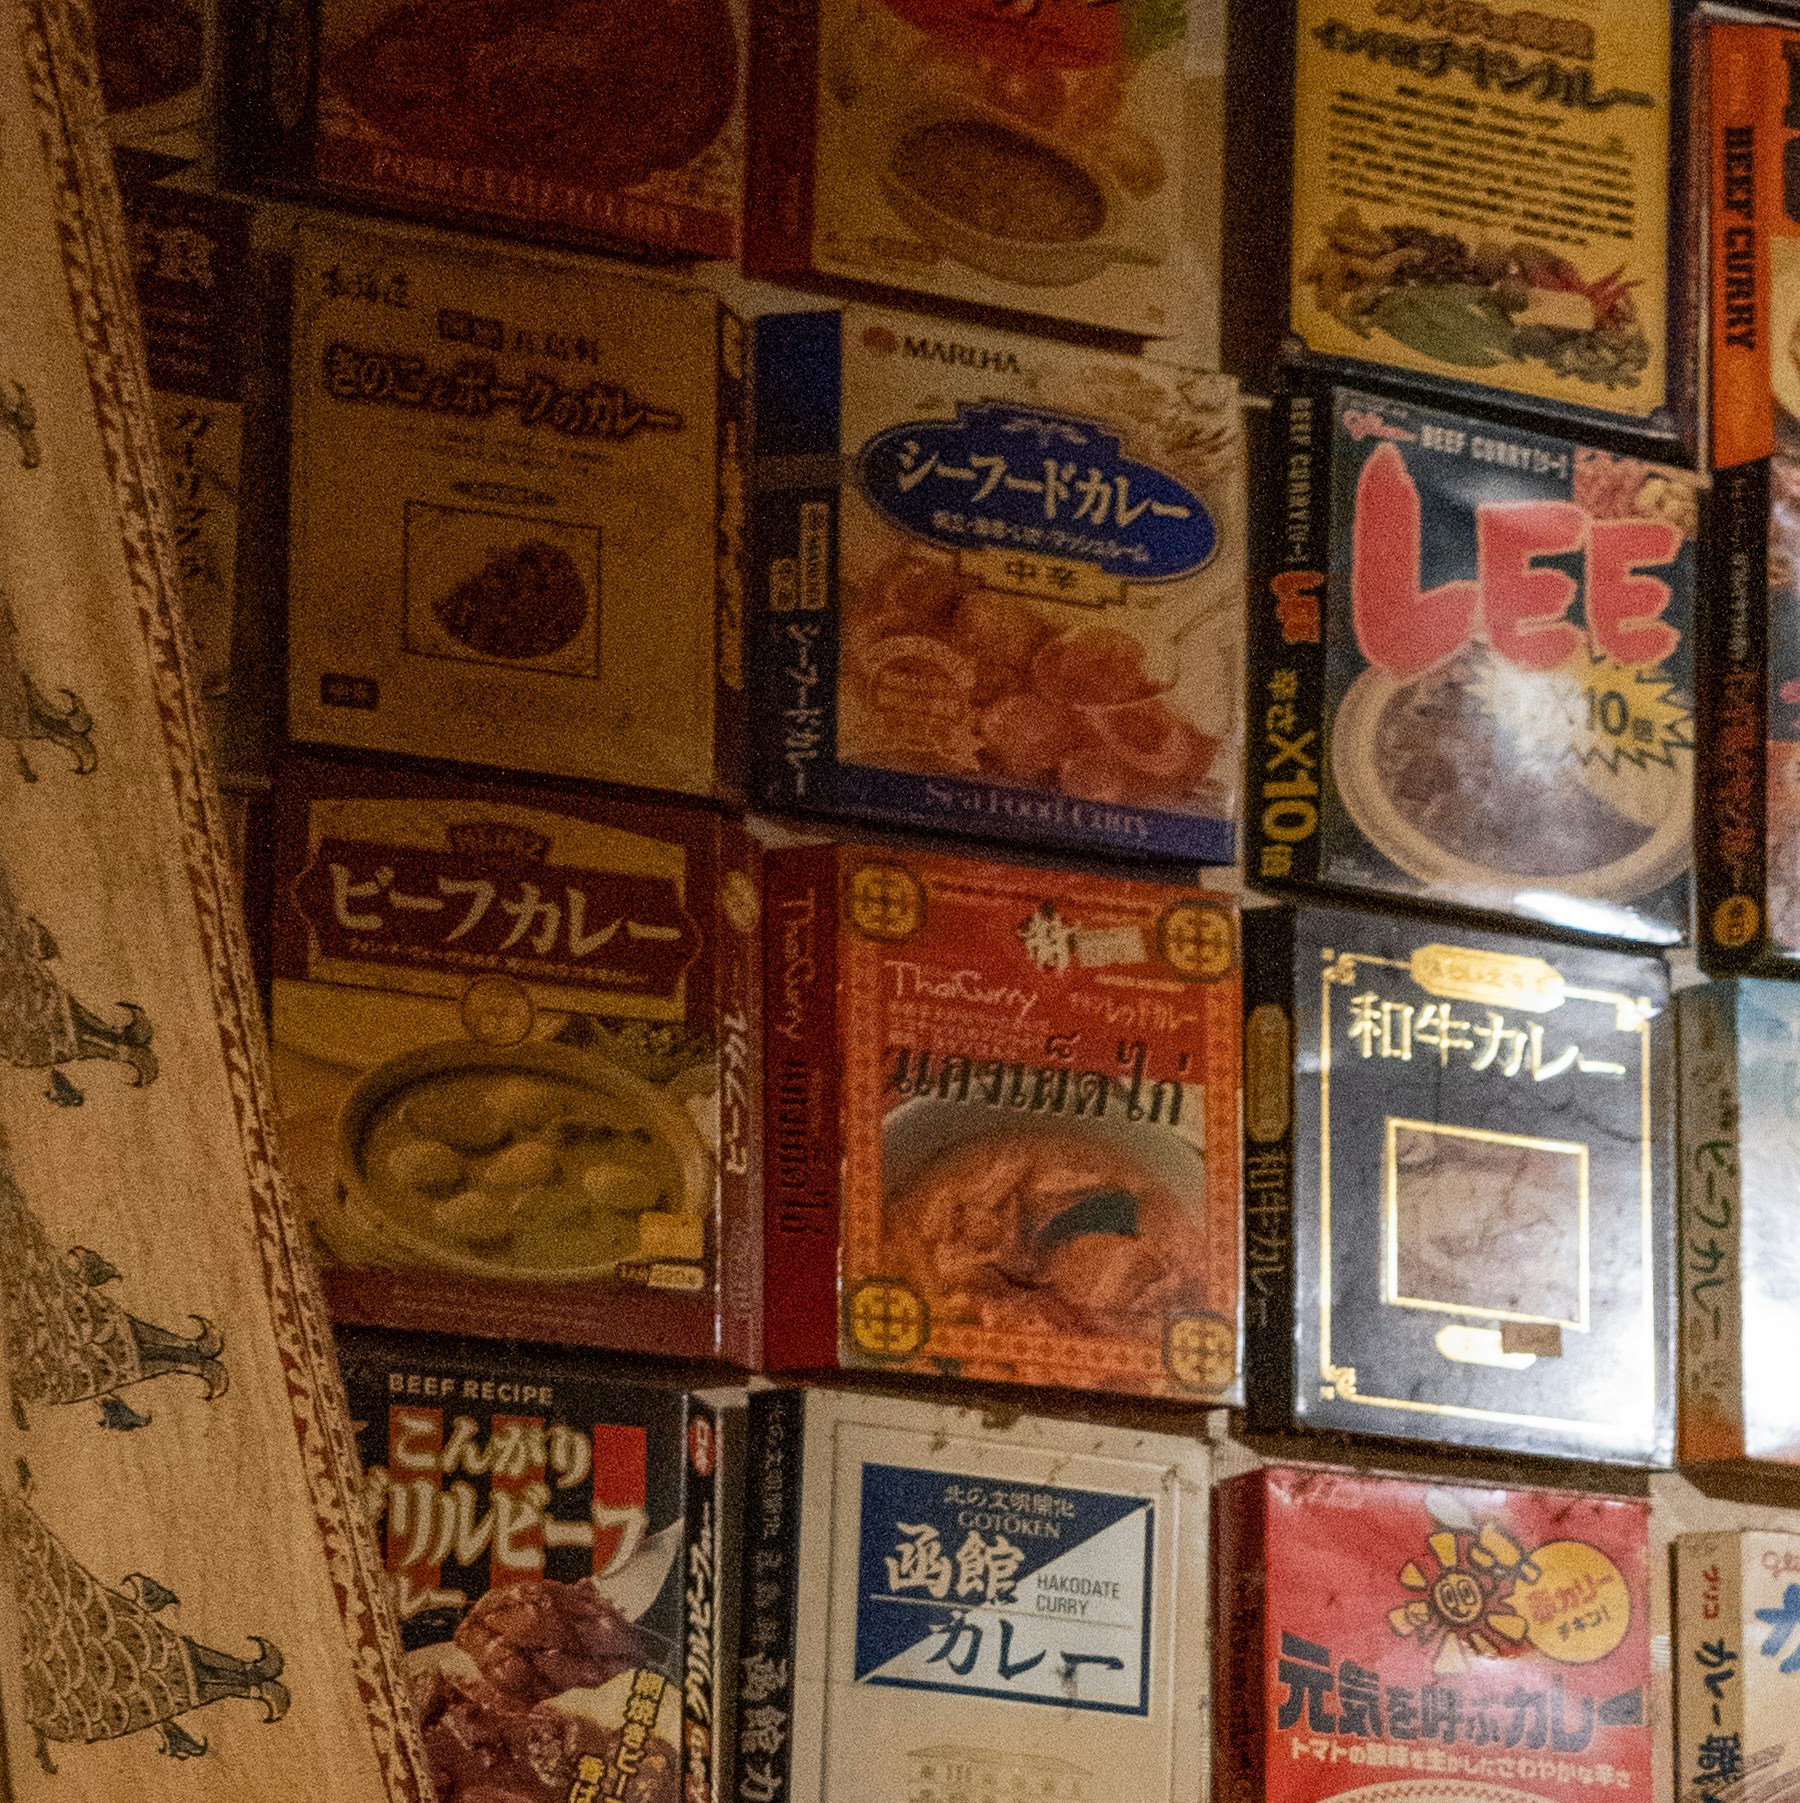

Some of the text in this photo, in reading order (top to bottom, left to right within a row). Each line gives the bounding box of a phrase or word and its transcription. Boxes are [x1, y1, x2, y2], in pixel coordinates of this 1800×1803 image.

[1421, 425, 1466, 455] BEEF
[897, 439, 1190, 529] シーフードカレー
[1352, 440, 1685, 683] LEE
[1270, 571, 1326, 645] LEE
[329, 863, 682, 956] ビーフカレー
[1348, 991, 1626, 1082] 和牛カレー
[389, 1373, 553, 1406] BEEF RECIPE
[394, 1414, 593, 1489] こんがり
[958, 1510, 1061, 1540] GOTOKEN
[884, 1521, 1026, 1604] 函館
[1036, 1573, 1120, 1600] HAKODATE
[1036, 1595, 1090, 1618] CURRY
[926, 1609, 1125, 1681] カレー
[1277, 1629, 1643, 1754] 元気を呼ぶカレー
